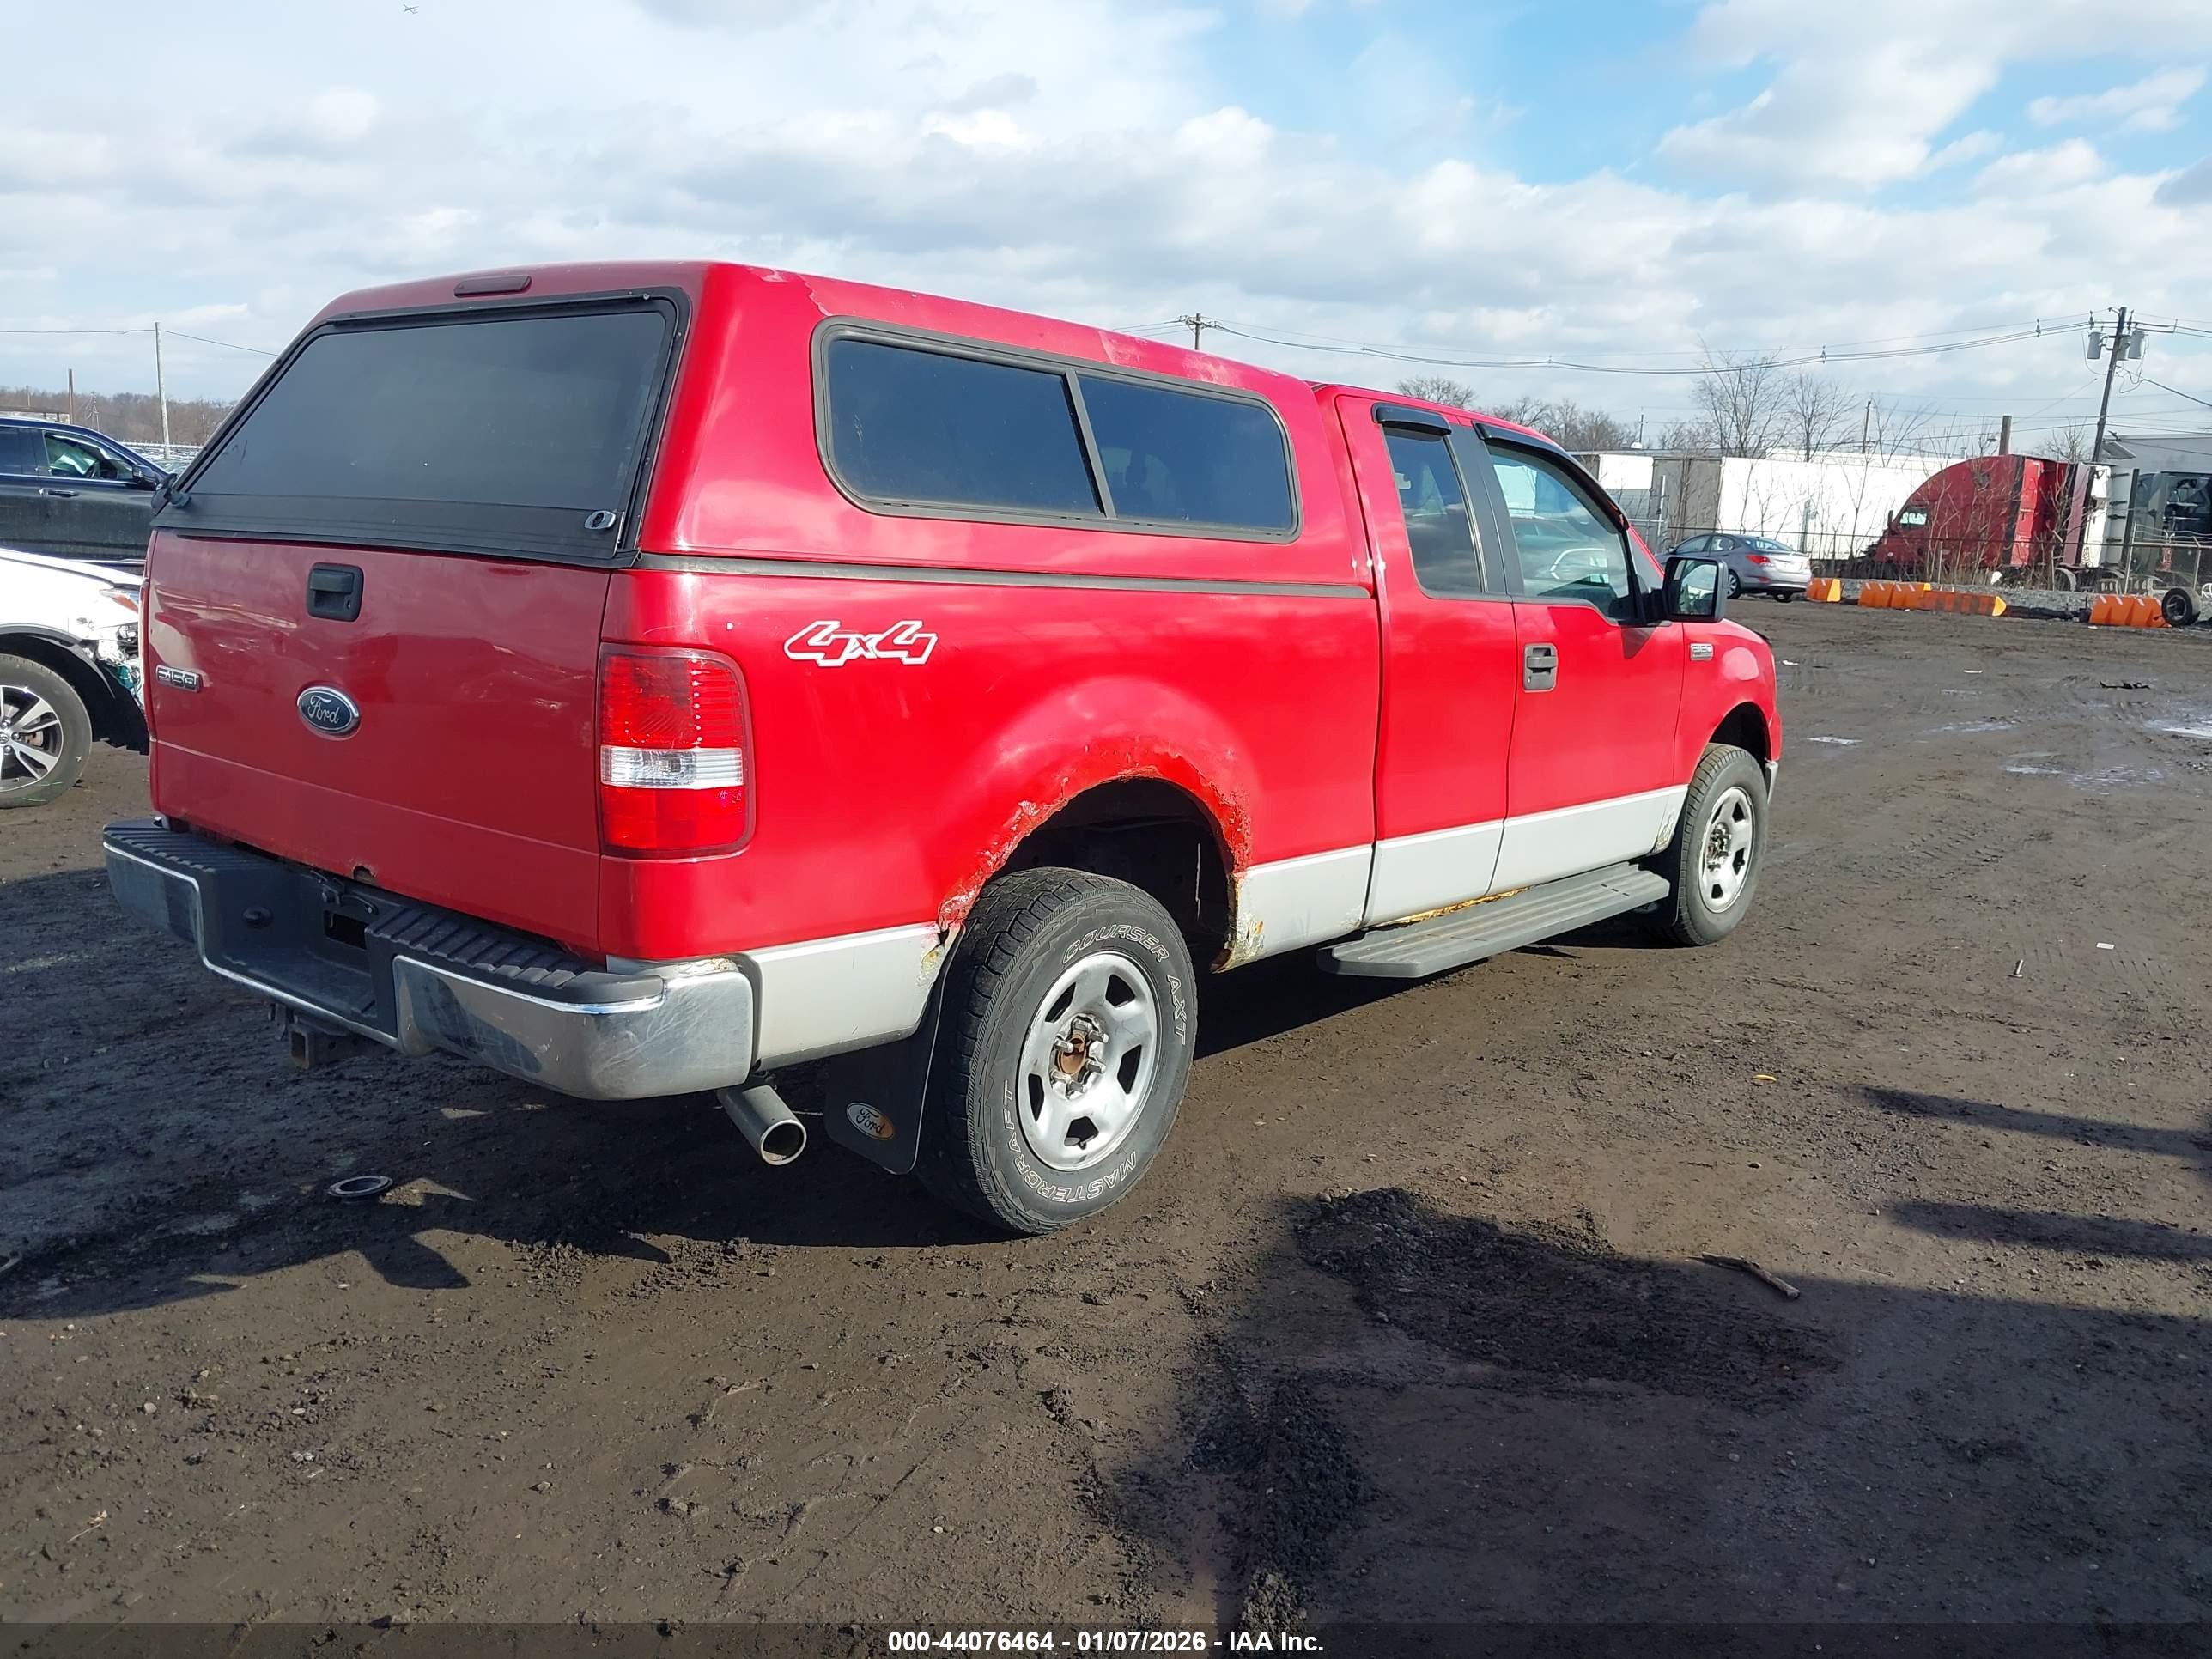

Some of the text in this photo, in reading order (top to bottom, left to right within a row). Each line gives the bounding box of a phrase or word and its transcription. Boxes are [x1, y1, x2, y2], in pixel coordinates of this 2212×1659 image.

[783, 619, 939, 667] 4x4
[307, 695, 341, 724] Ford
[1062, 924, 1187, 1045] COURSER AXT
[855, 1108, 886, 1134] Ford
[1003, 1079, 1138, 1204] MASTERCRAFT
